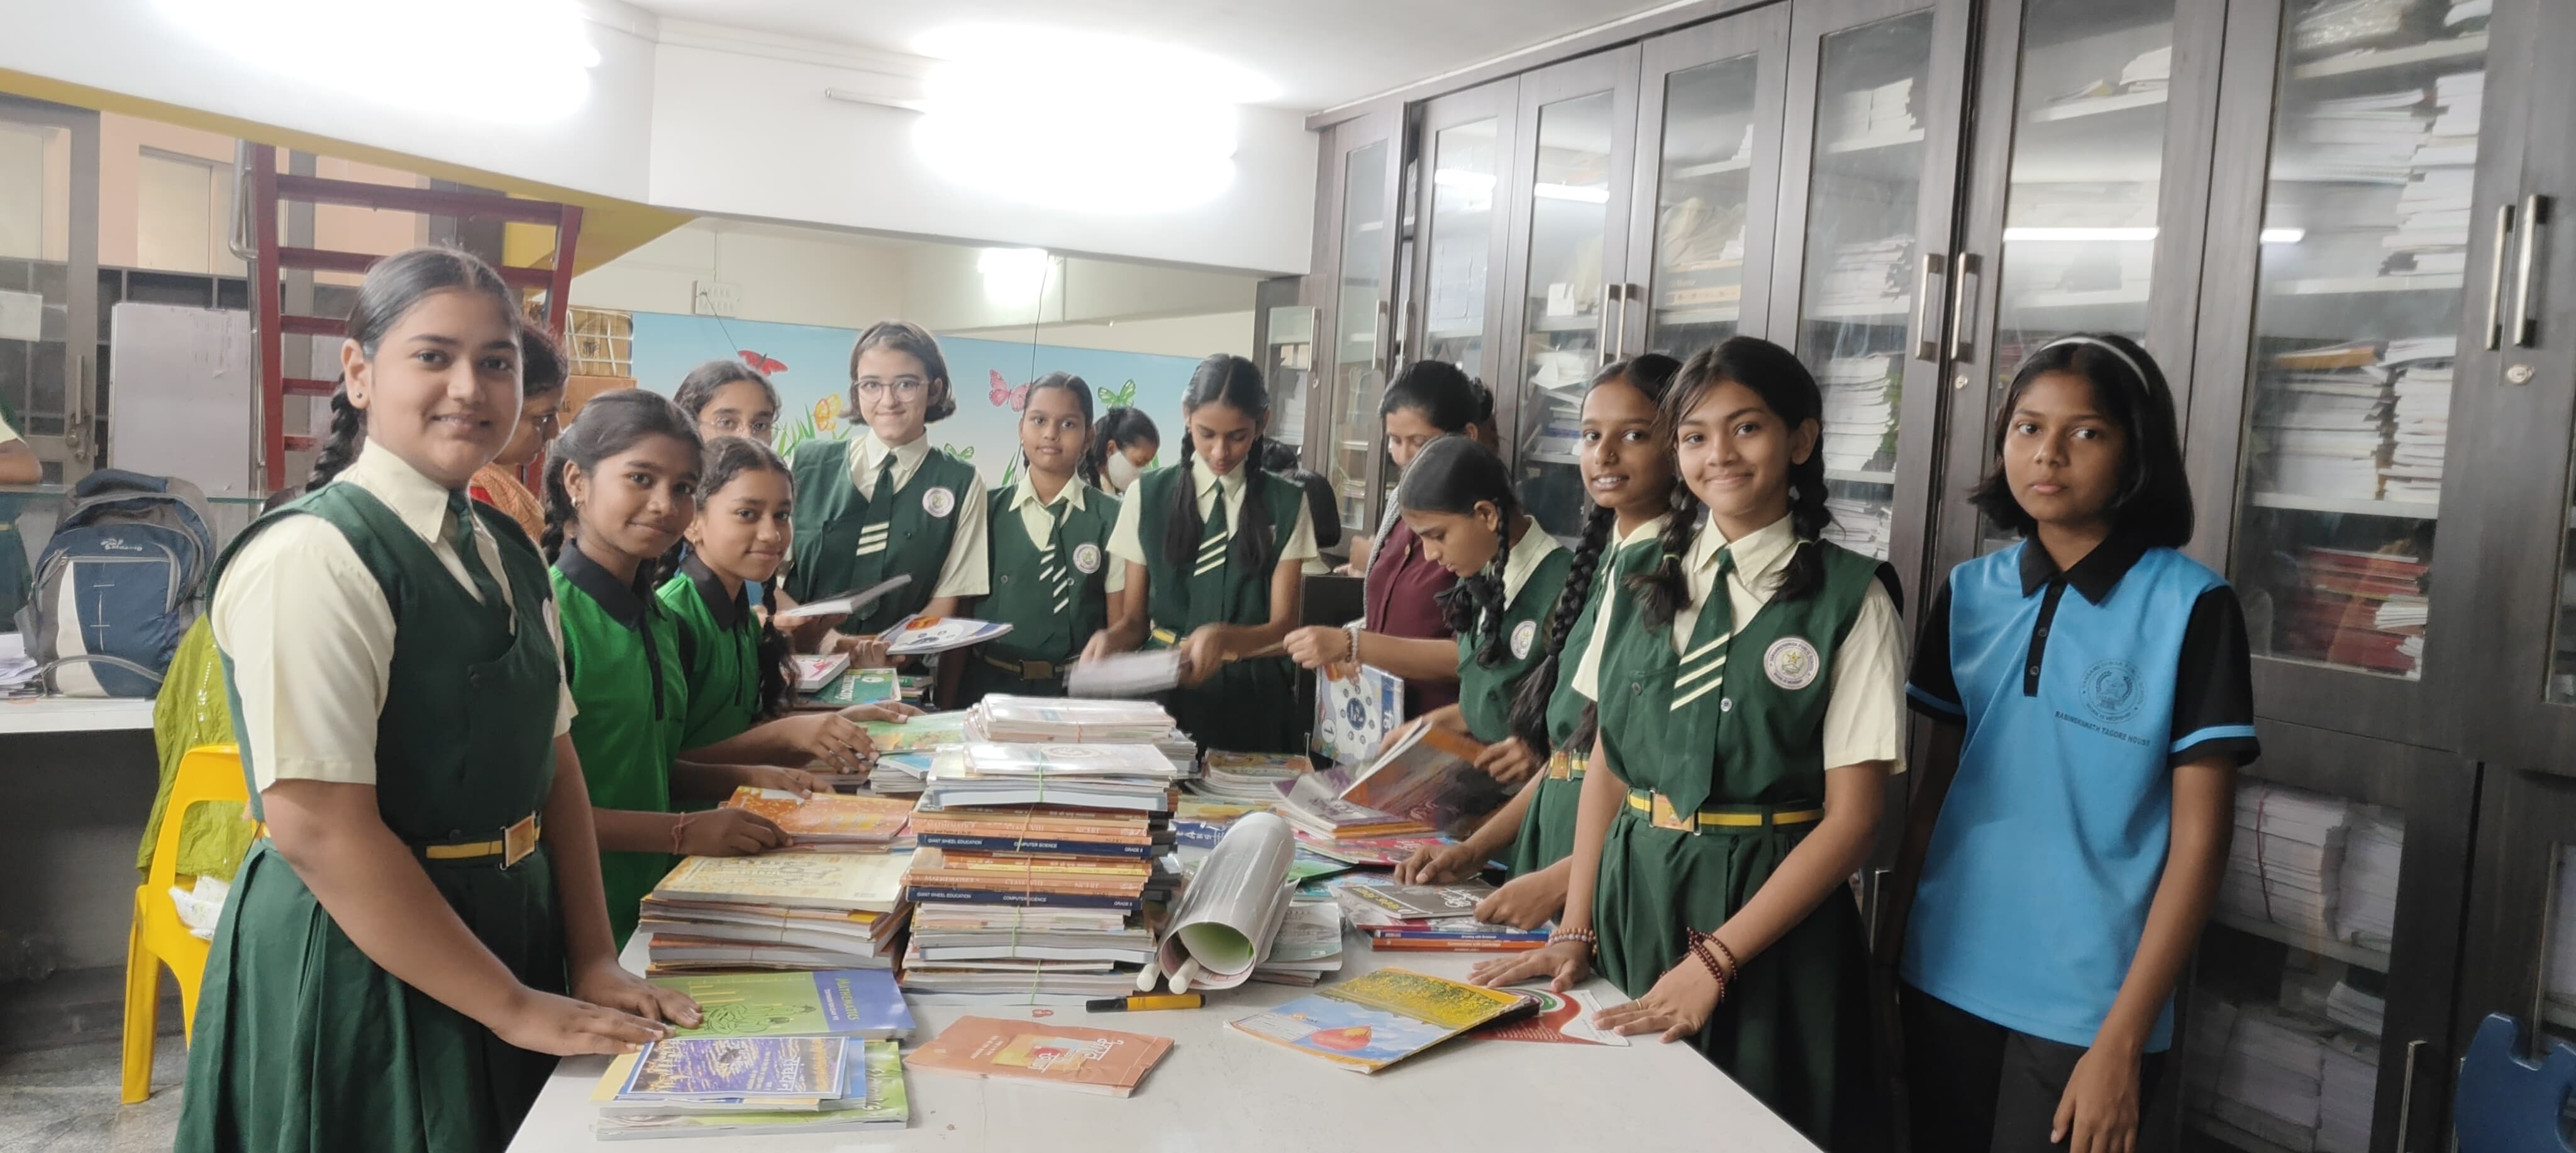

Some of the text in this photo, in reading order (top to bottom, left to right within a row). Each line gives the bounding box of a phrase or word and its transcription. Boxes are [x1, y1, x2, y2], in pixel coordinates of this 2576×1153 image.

[2054, 710, 2150, 747] RABINDRANATH TAGORE HOUSE
[835, 978, 860, 1020] MATHEMATICS
[1084, 1038, 1124, 1061] भारत
[776, 1057, 805, 1092] संचयन
